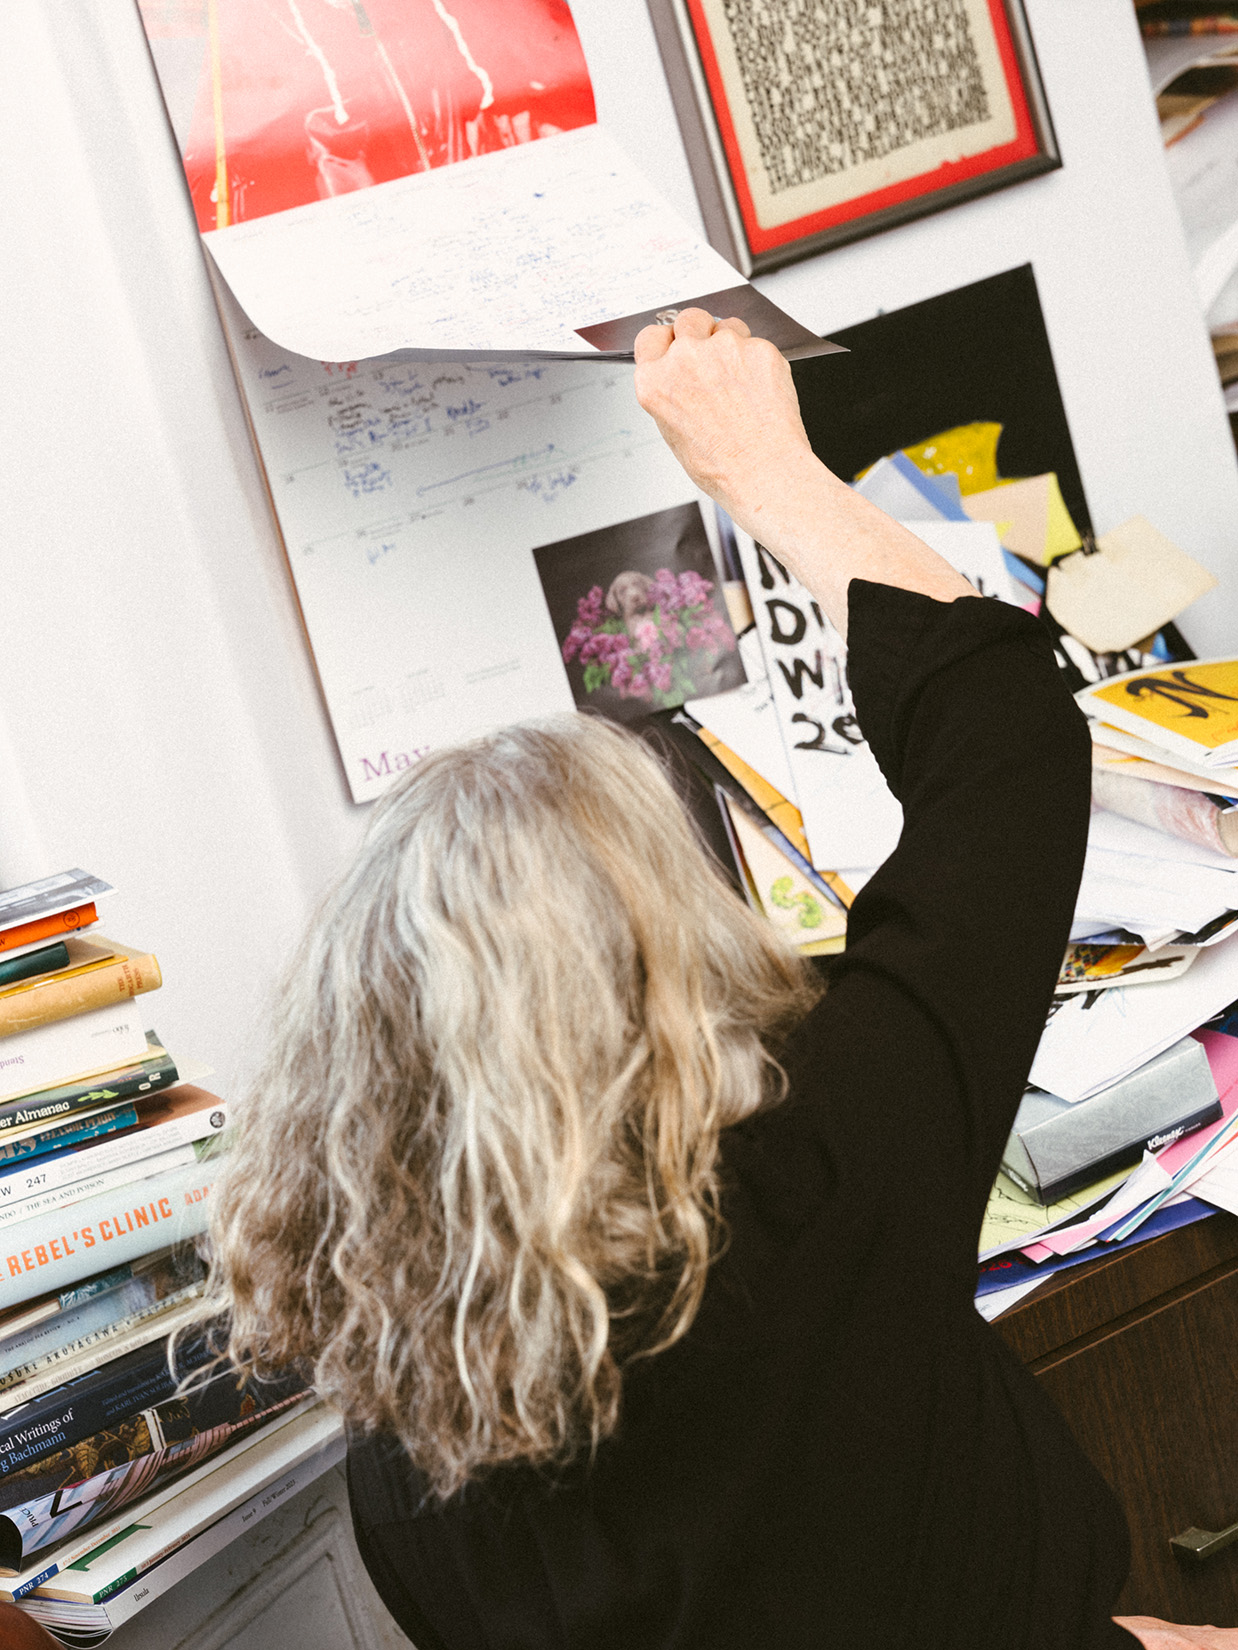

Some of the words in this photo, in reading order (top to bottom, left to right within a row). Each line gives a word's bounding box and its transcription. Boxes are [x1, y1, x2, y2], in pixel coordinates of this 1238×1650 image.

[14, 1101, 71, 1125] Almanac
[1147, 1127, 1184, 1150] Kleenex
[26, 1173, 47, 1188] 247
[26, 1201, 41, 1211] THE
[43, 1196, 57, 1206] SEA
[59, 1189, 76, 1201] AND
[77, 1178, 105, 1194] POISON
[6, 1227, 96, 1277] REBEL'S
[98, 1197, 173, 1242] CLINIC
[184, 1183, 215, 1206] ADA
[44, 1324, 119, 1363] AKUTAGAWA
[0, 1437, 14, 1453] cal
[15, 1417, 62, 1445] Writings
[62, 1407, 74, 1424] of
[0, 1460, 10, 1473] g
[8, 1431, 66, 1465] Bachmann
[133, 1588, 150, 1602] Ursula
[241, 1512, 253, 1523] Issue
[19, 1582, 35, 1596] PNR
[36, 1572, 49, 1585] 274
[99, 1584, 114, 1599] PNR
